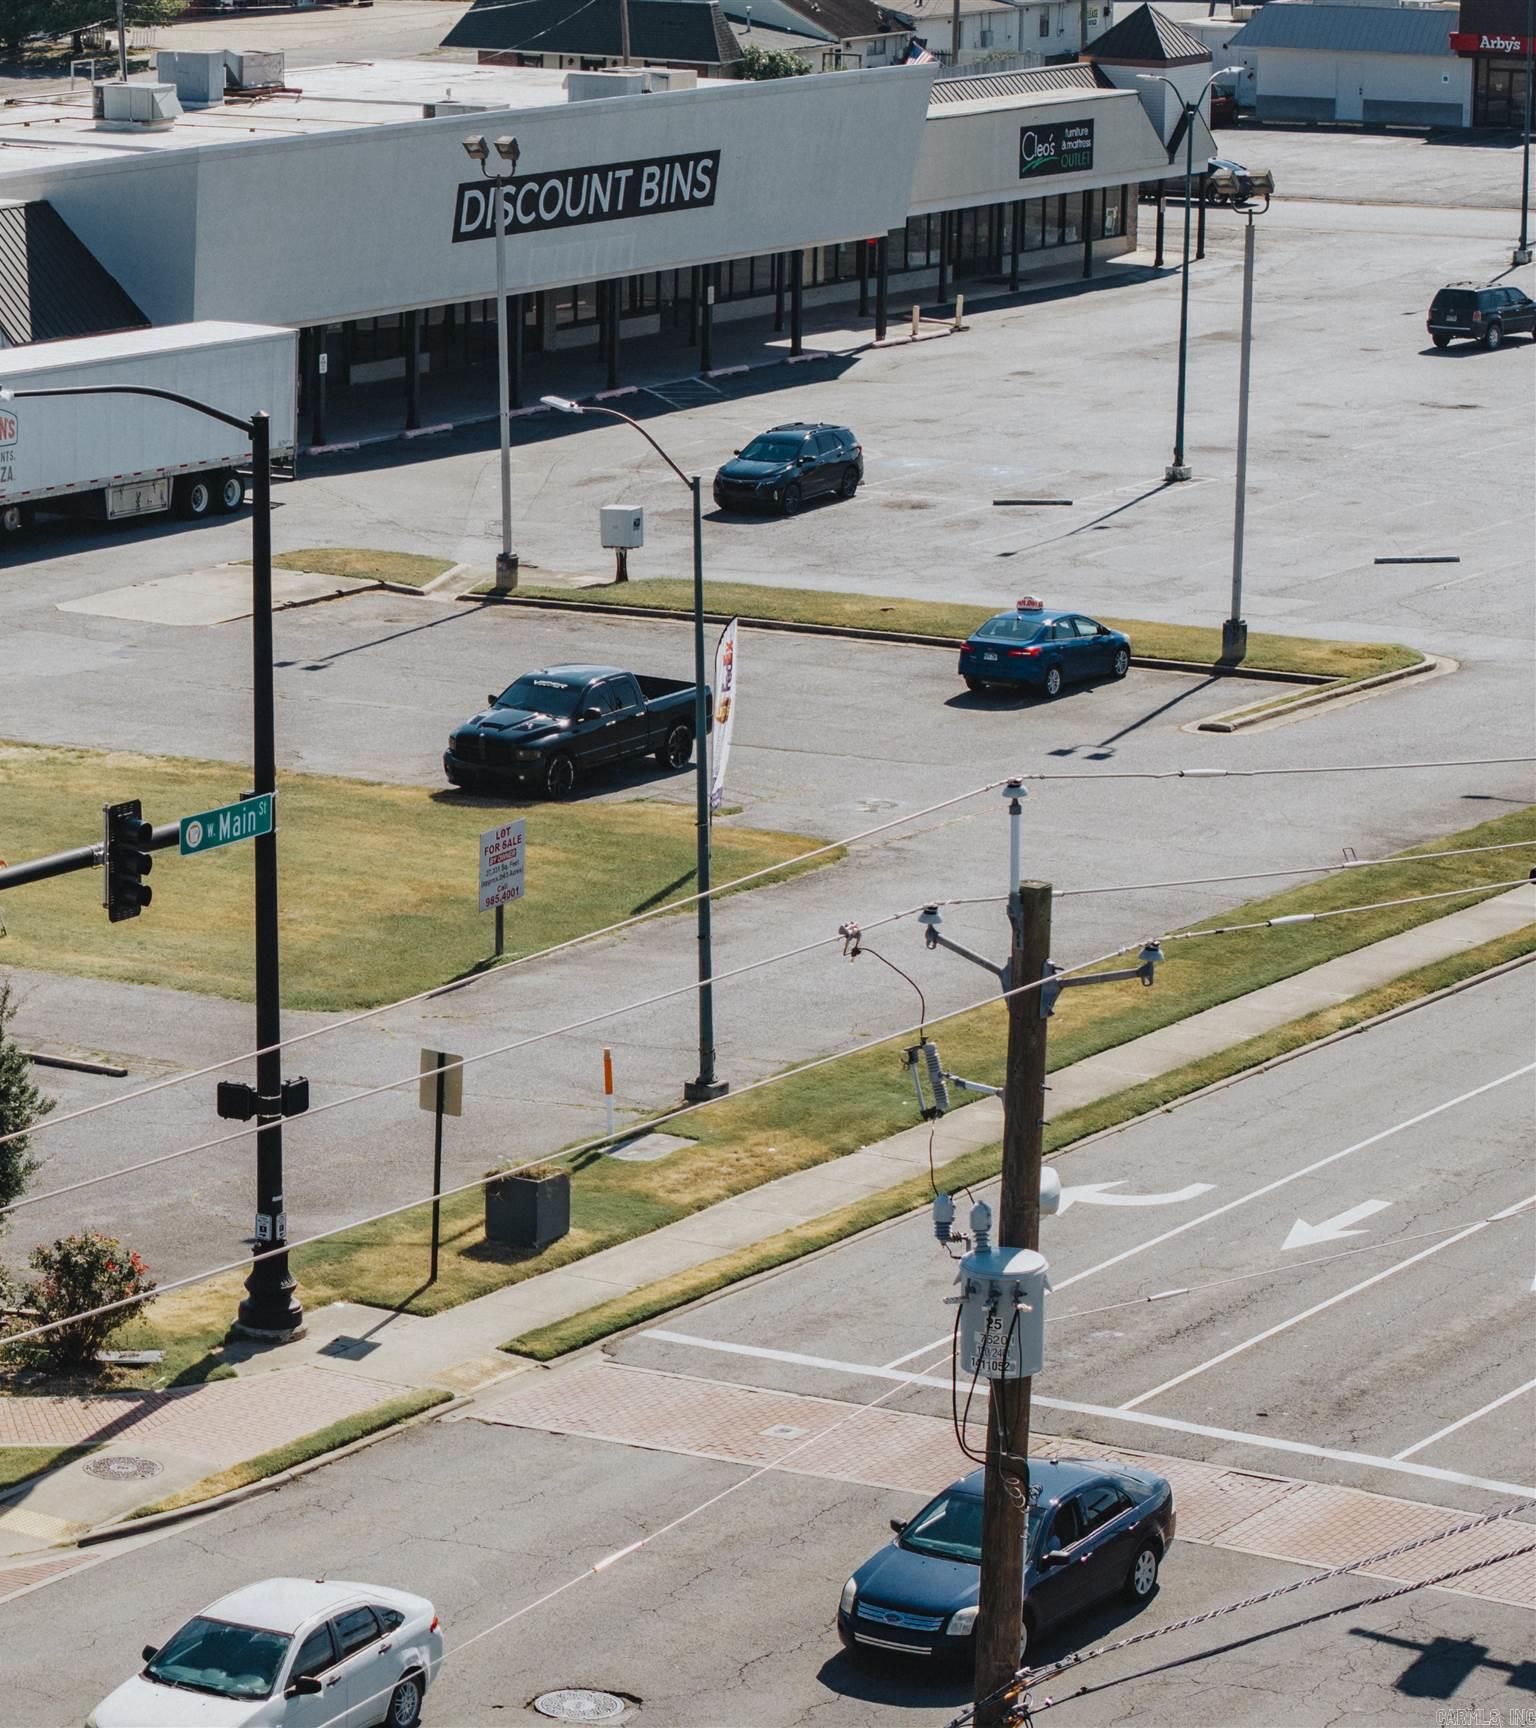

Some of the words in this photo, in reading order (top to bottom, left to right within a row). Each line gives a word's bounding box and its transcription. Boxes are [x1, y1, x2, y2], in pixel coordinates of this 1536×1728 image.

[1479, 35, 1521, 53] Arby's
[1021, 131, 1056, 161] Cleo's
[1060, 151, 1090, 167] OUTLET
[460, 168, 634, 233] DISCOUNT
[639, 158, 713, 207] BINS
[219, 807, 256, 840] Main
[259, 801, 267, 815] St
[496, 826, 511, 840] LOT
[484, 843, 500, 856] FOR
[502, 834, 522, 849] SALE
[485, 887, 520, 907] 985.4001
[986, 1318, 1002, 1330] 25
